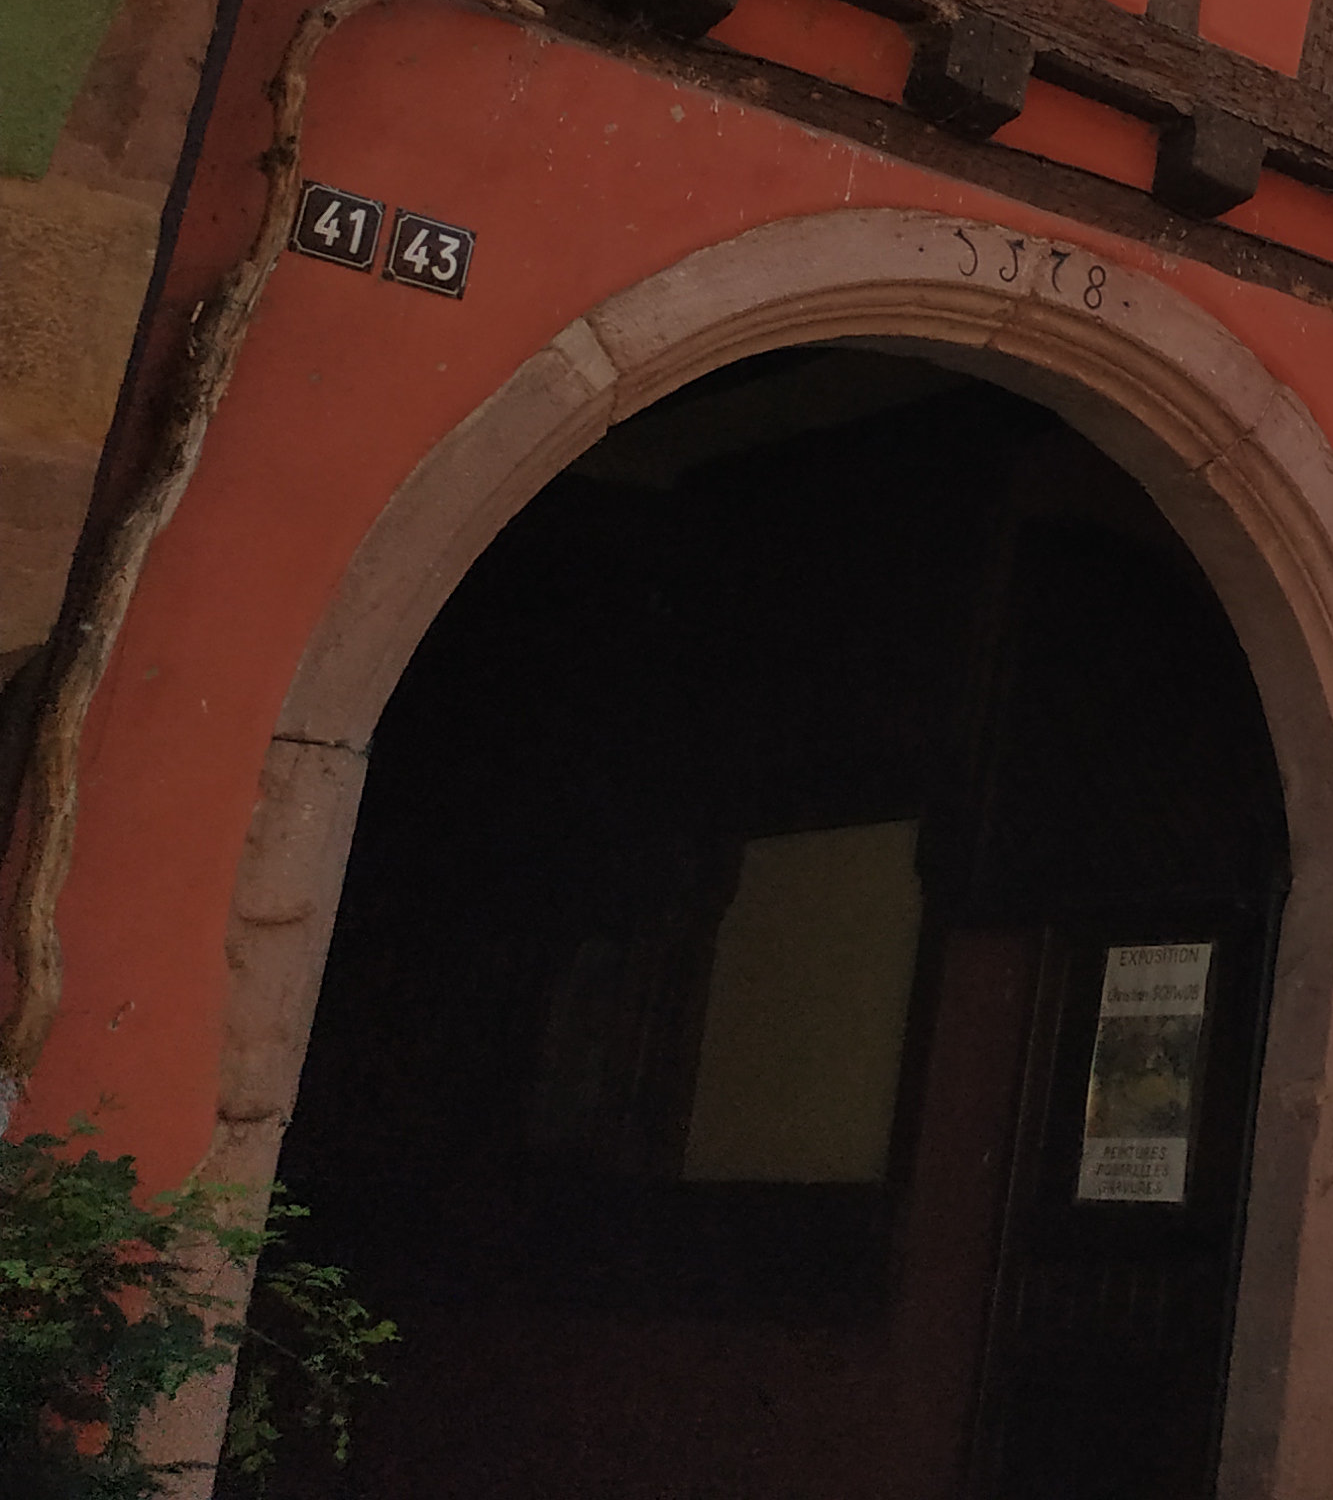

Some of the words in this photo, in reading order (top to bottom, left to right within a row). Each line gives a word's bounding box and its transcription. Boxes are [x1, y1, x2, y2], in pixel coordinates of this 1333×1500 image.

[312, 200, 367, 255] 41
[402, 228, 462, 282] 43
[1118, 947, 1200, 967] EXPOSITION
